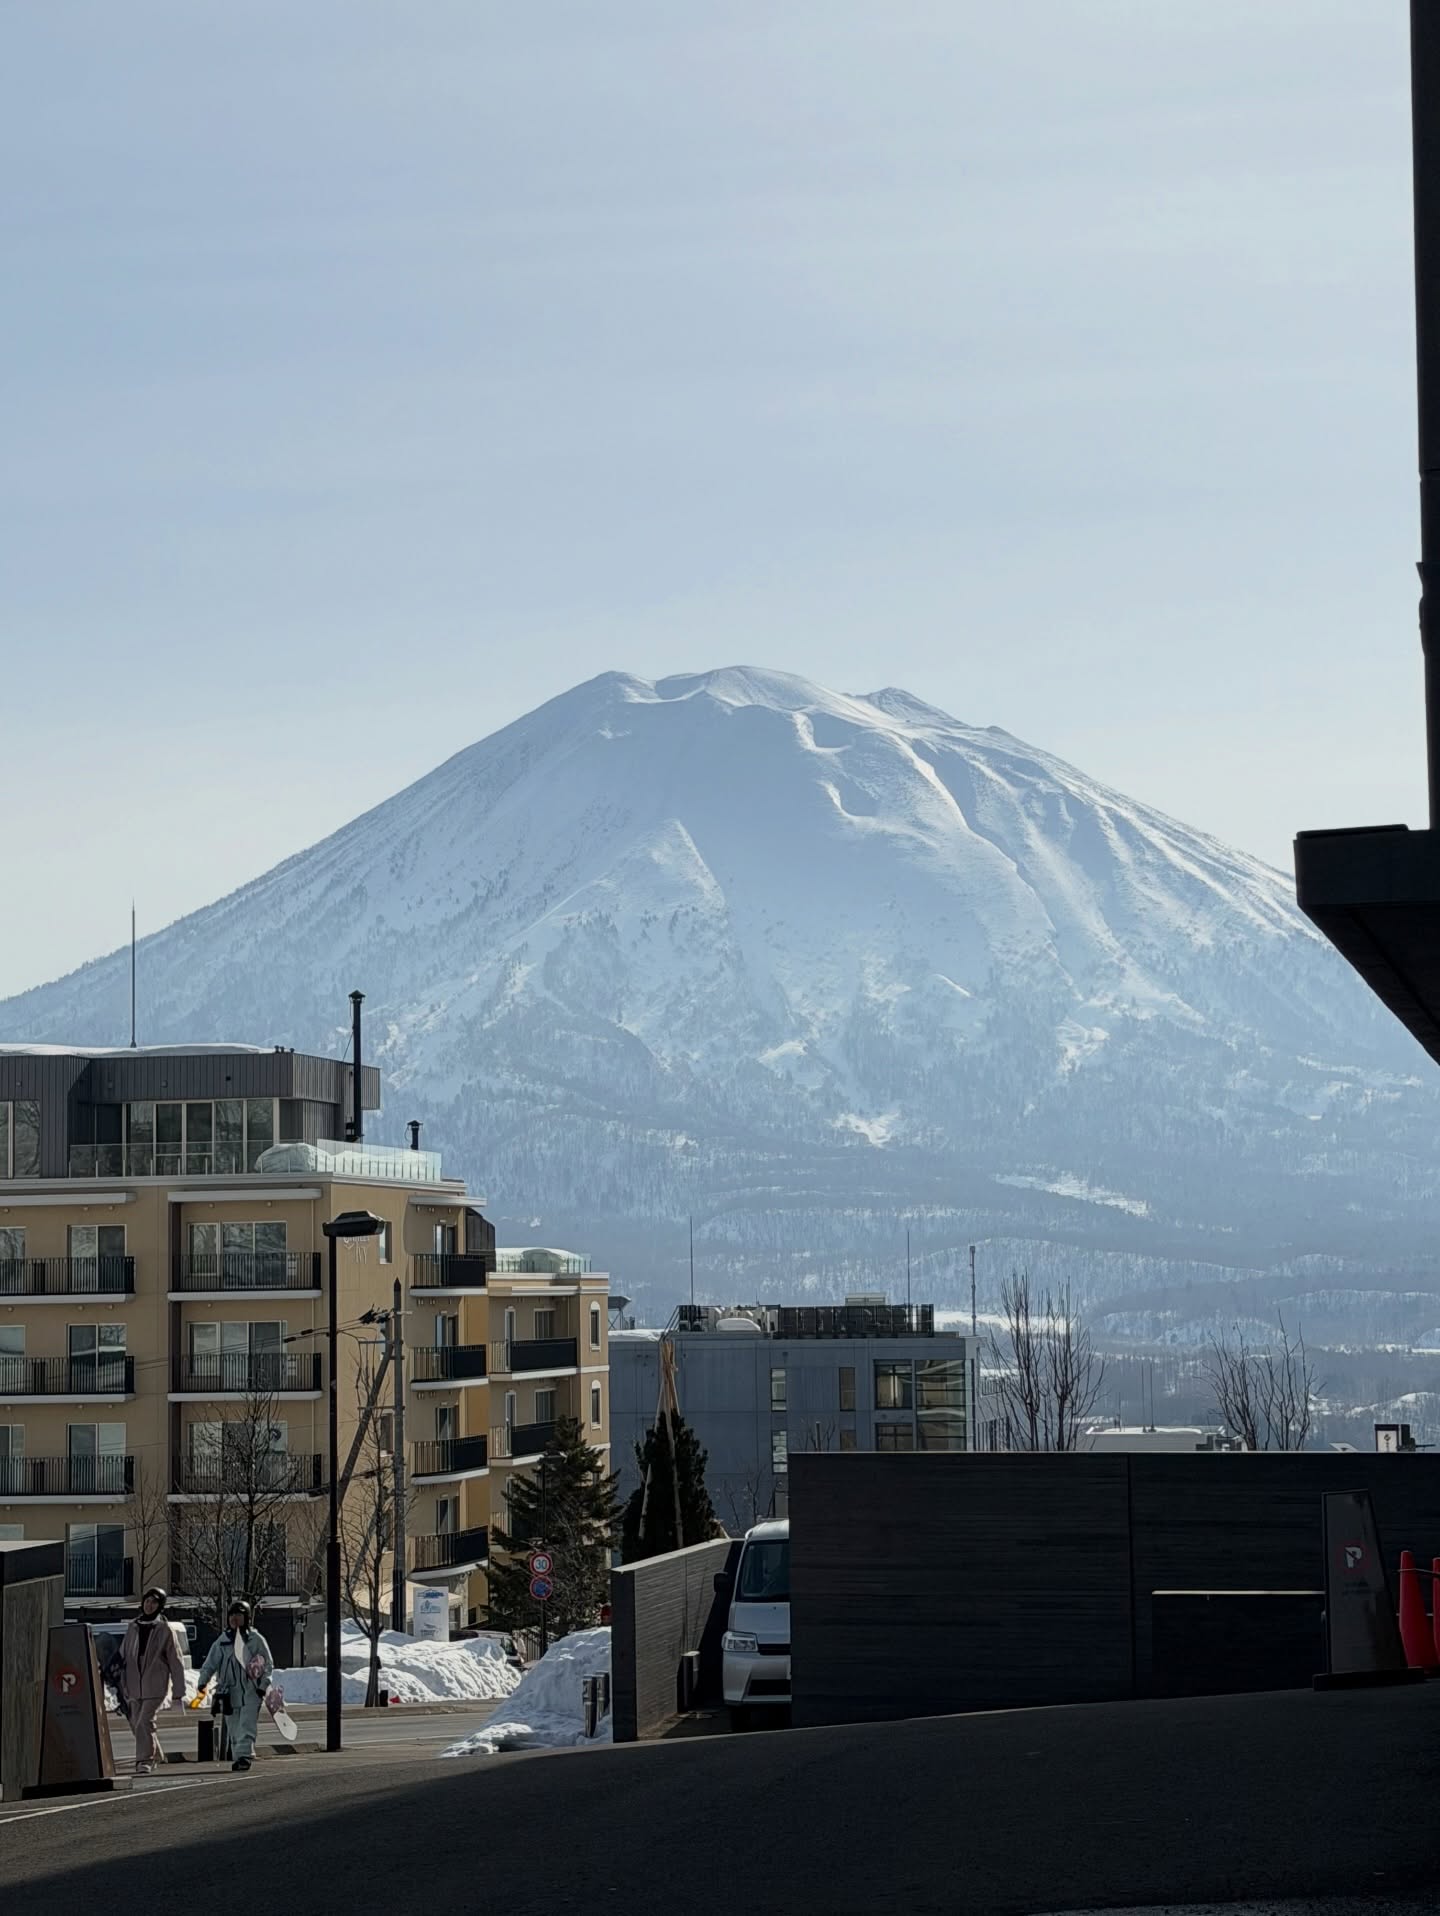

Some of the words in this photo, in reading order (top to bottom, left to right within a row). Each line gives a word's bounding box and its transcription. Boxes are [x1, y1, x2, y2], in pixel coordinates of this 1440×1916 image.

[535, 1559, 548, 1570] 30
[1344, 1546, 1362, 1568] P
[61, 1673, 76, 1693] P
